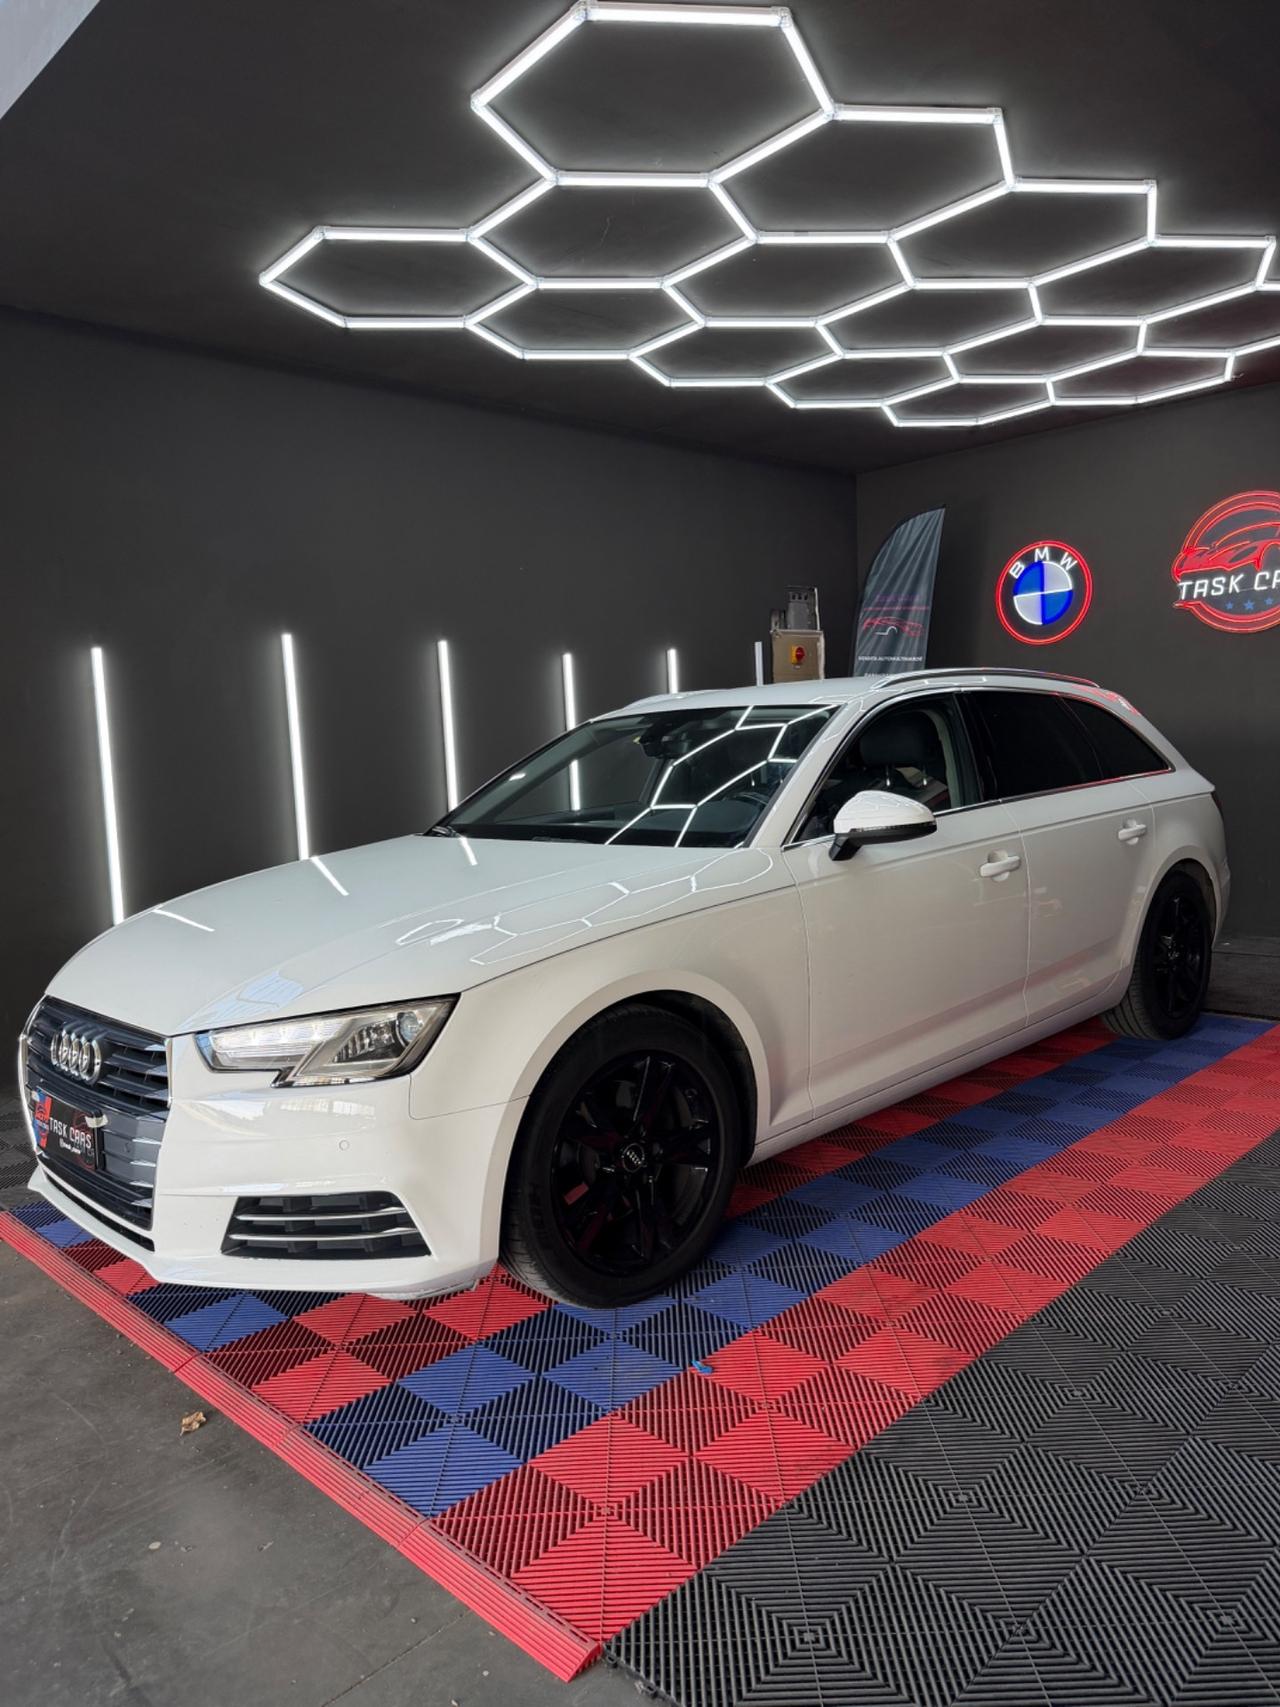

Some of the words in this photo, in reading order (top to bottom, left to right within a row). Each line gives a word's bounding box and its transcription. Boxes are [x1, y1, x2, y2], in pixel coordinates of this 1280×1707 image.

[1009, 546, 1078, 580] BMW
[1177, 573, 1244, 600] TASK
[49, 1118, 68, 1138] TASK
[69, 1127, 92, 1149] CARS
